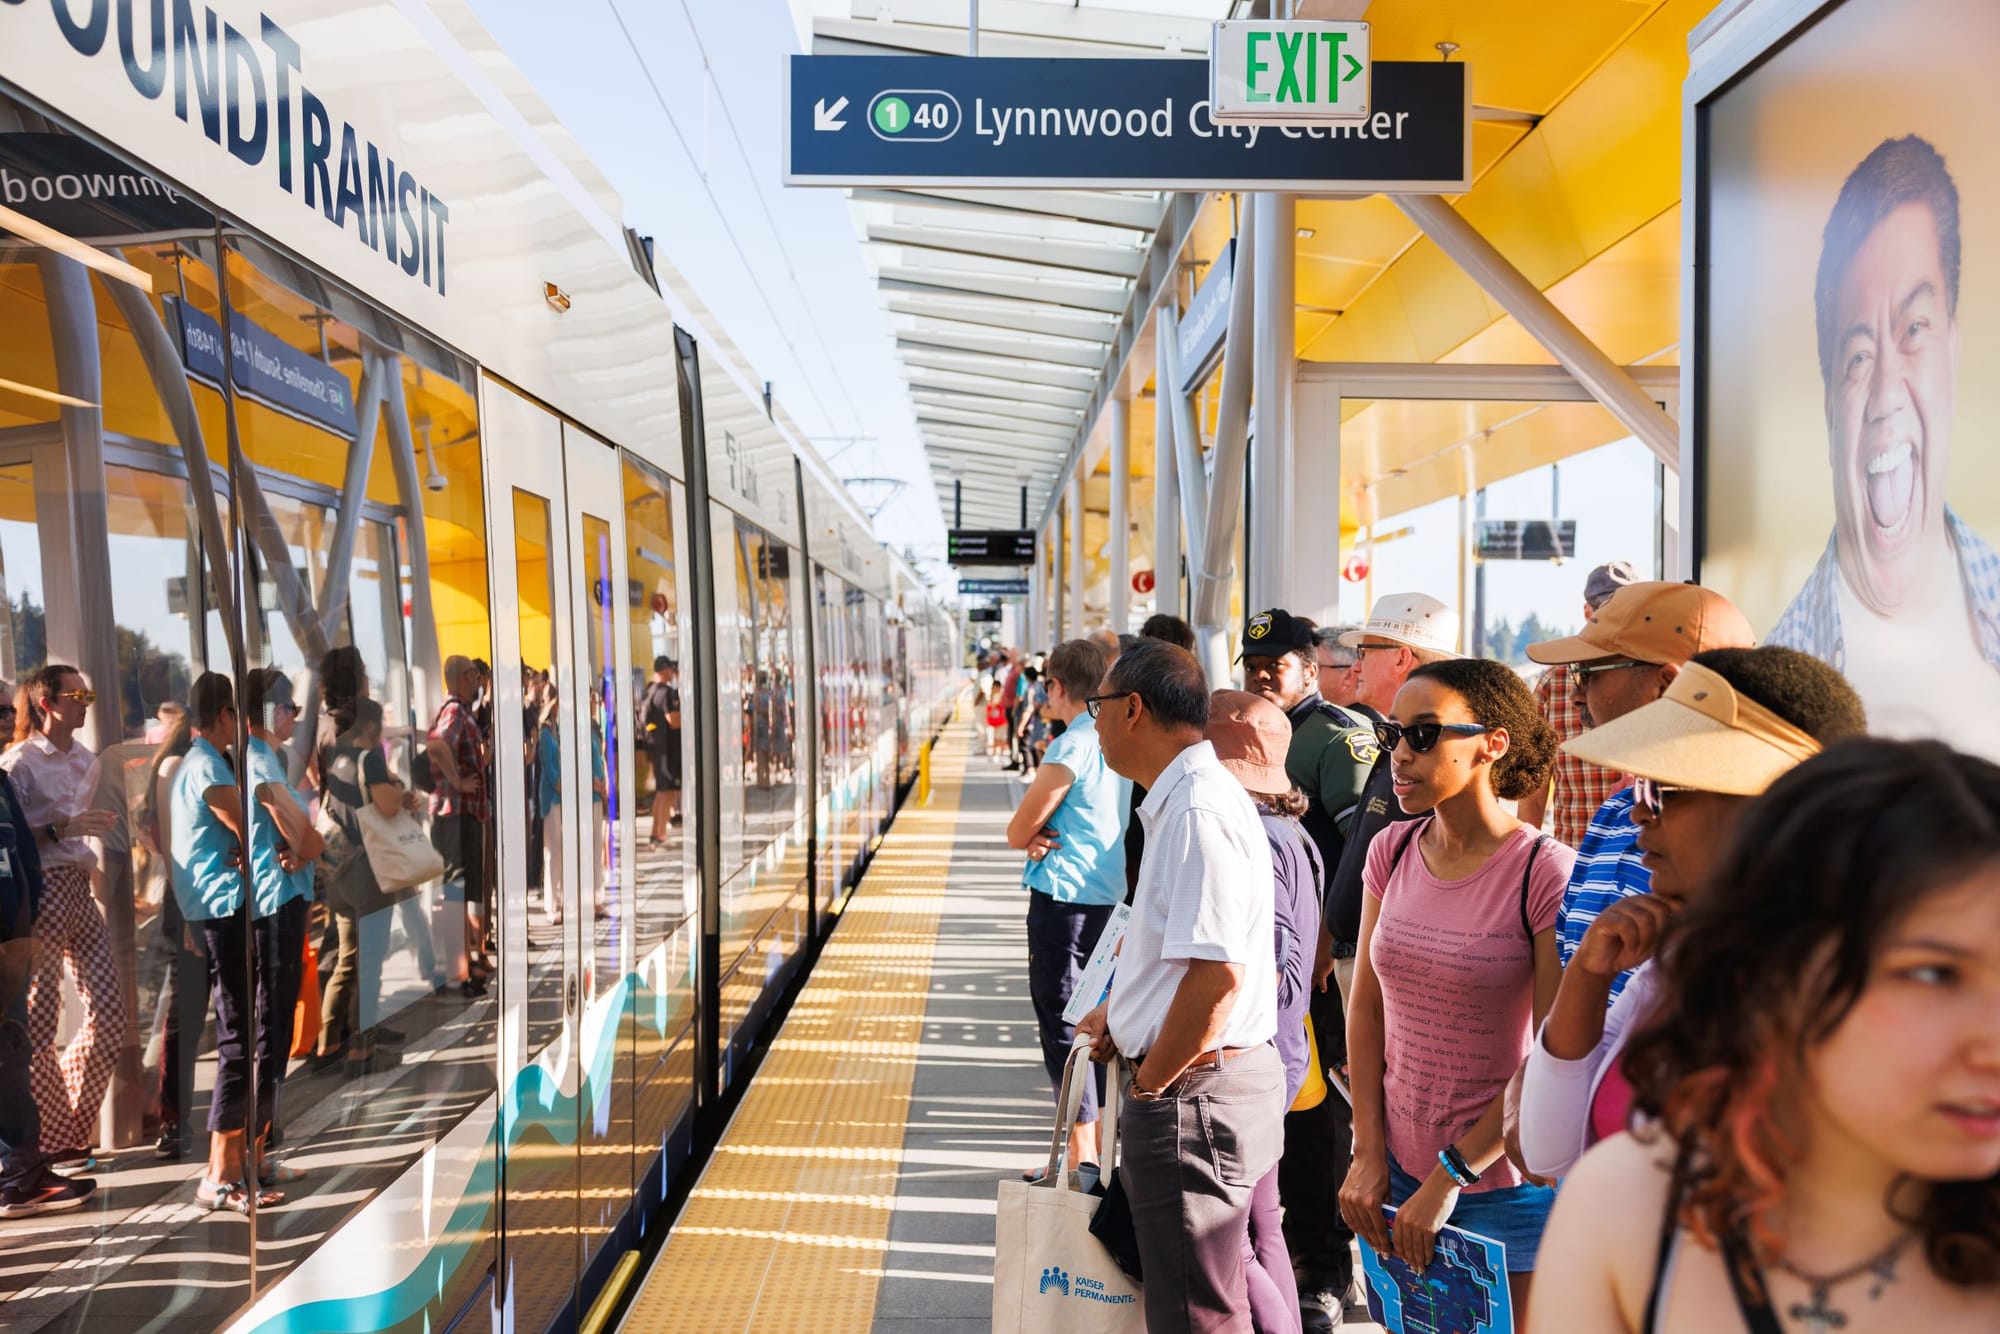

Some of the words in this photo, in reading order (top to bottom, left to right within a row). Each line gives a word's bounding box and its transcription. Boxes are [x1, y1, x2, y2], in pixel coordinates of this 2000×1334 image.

[1246, 32, 1347, 104] EXIT
[913, 103, 949, 129] 40
[975, 97, 1173, 146] Lynnwood
[0, 0, 449, 297] UNDTRANSIT
[1074, 1288, 1133, 1304] PERMANENTE
[1075, 1276, 1105, 1291] KAISER
